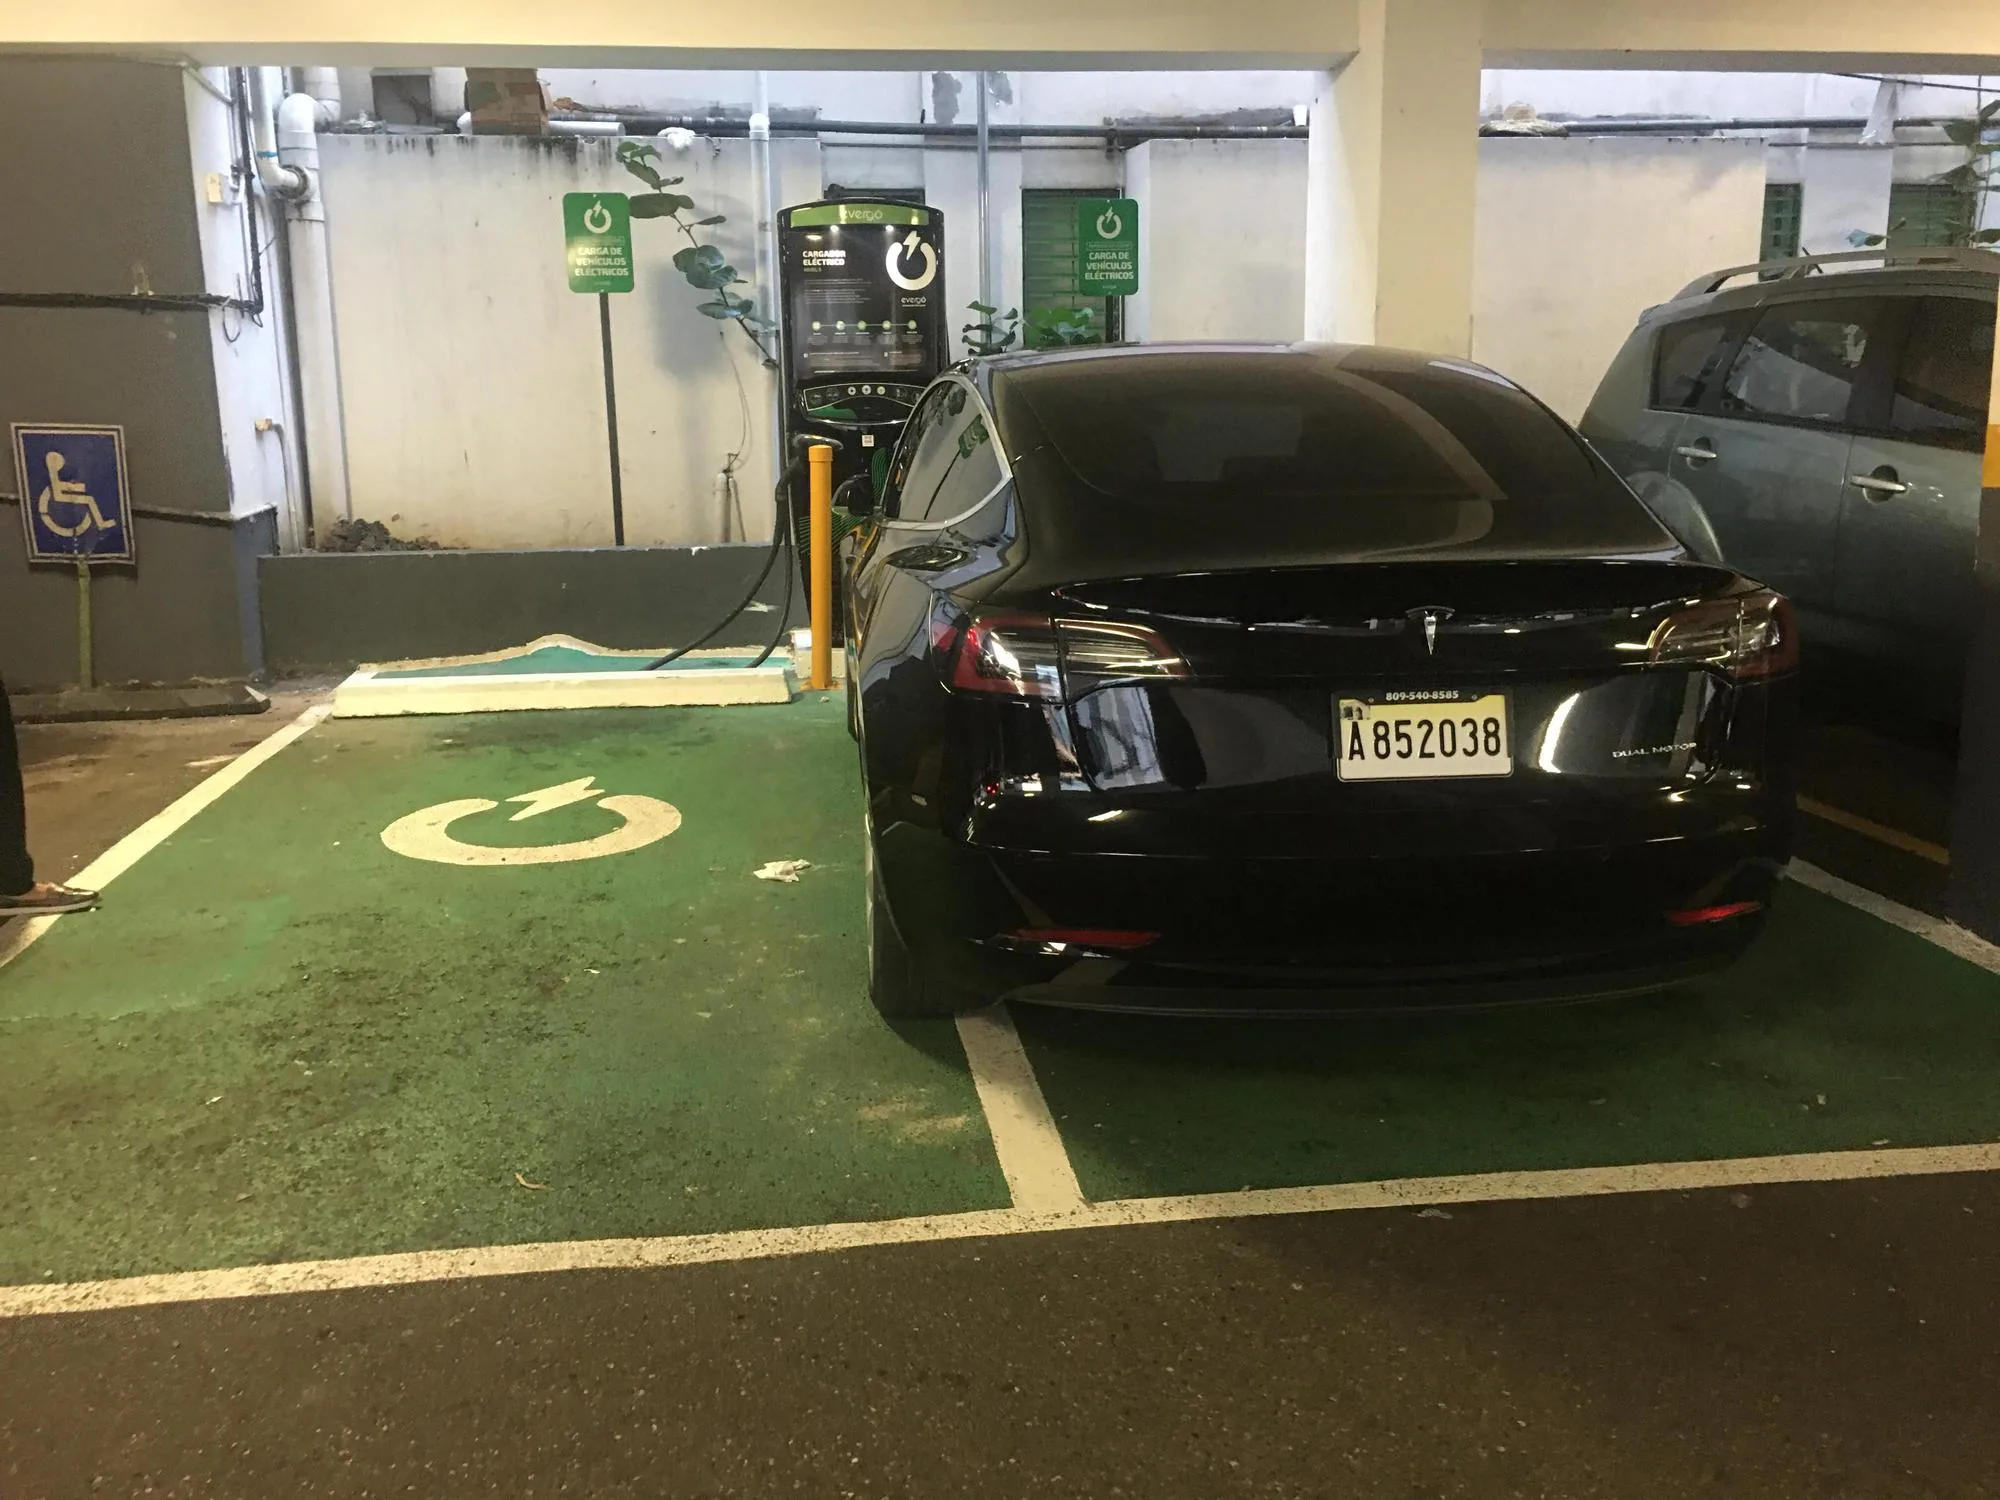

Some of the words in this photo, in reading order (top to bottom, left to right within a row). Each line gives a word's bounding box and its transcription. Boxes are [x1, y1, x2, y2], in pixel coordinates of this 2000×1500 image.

[577, 246, 609, 256] CARGA
[610, 247, 622, 256] DE
[803, 250, 846, 258] CARGAR
[1088, 252, 1117, 260] CARGA
[1118, 252, 1129, 260] DE
[575, 256, 627, 266] VEHÍCULOS
[1086, 261, 1133, 270] VEHÍCULOS
[1084, 271, 1135, 280] ELÉCTRICOS
[1385, 690, 1459, 701] 809-540-8585
[1348, 717, 1501, 760] A852038
[1612, 748, 1649, 758] DUAL
